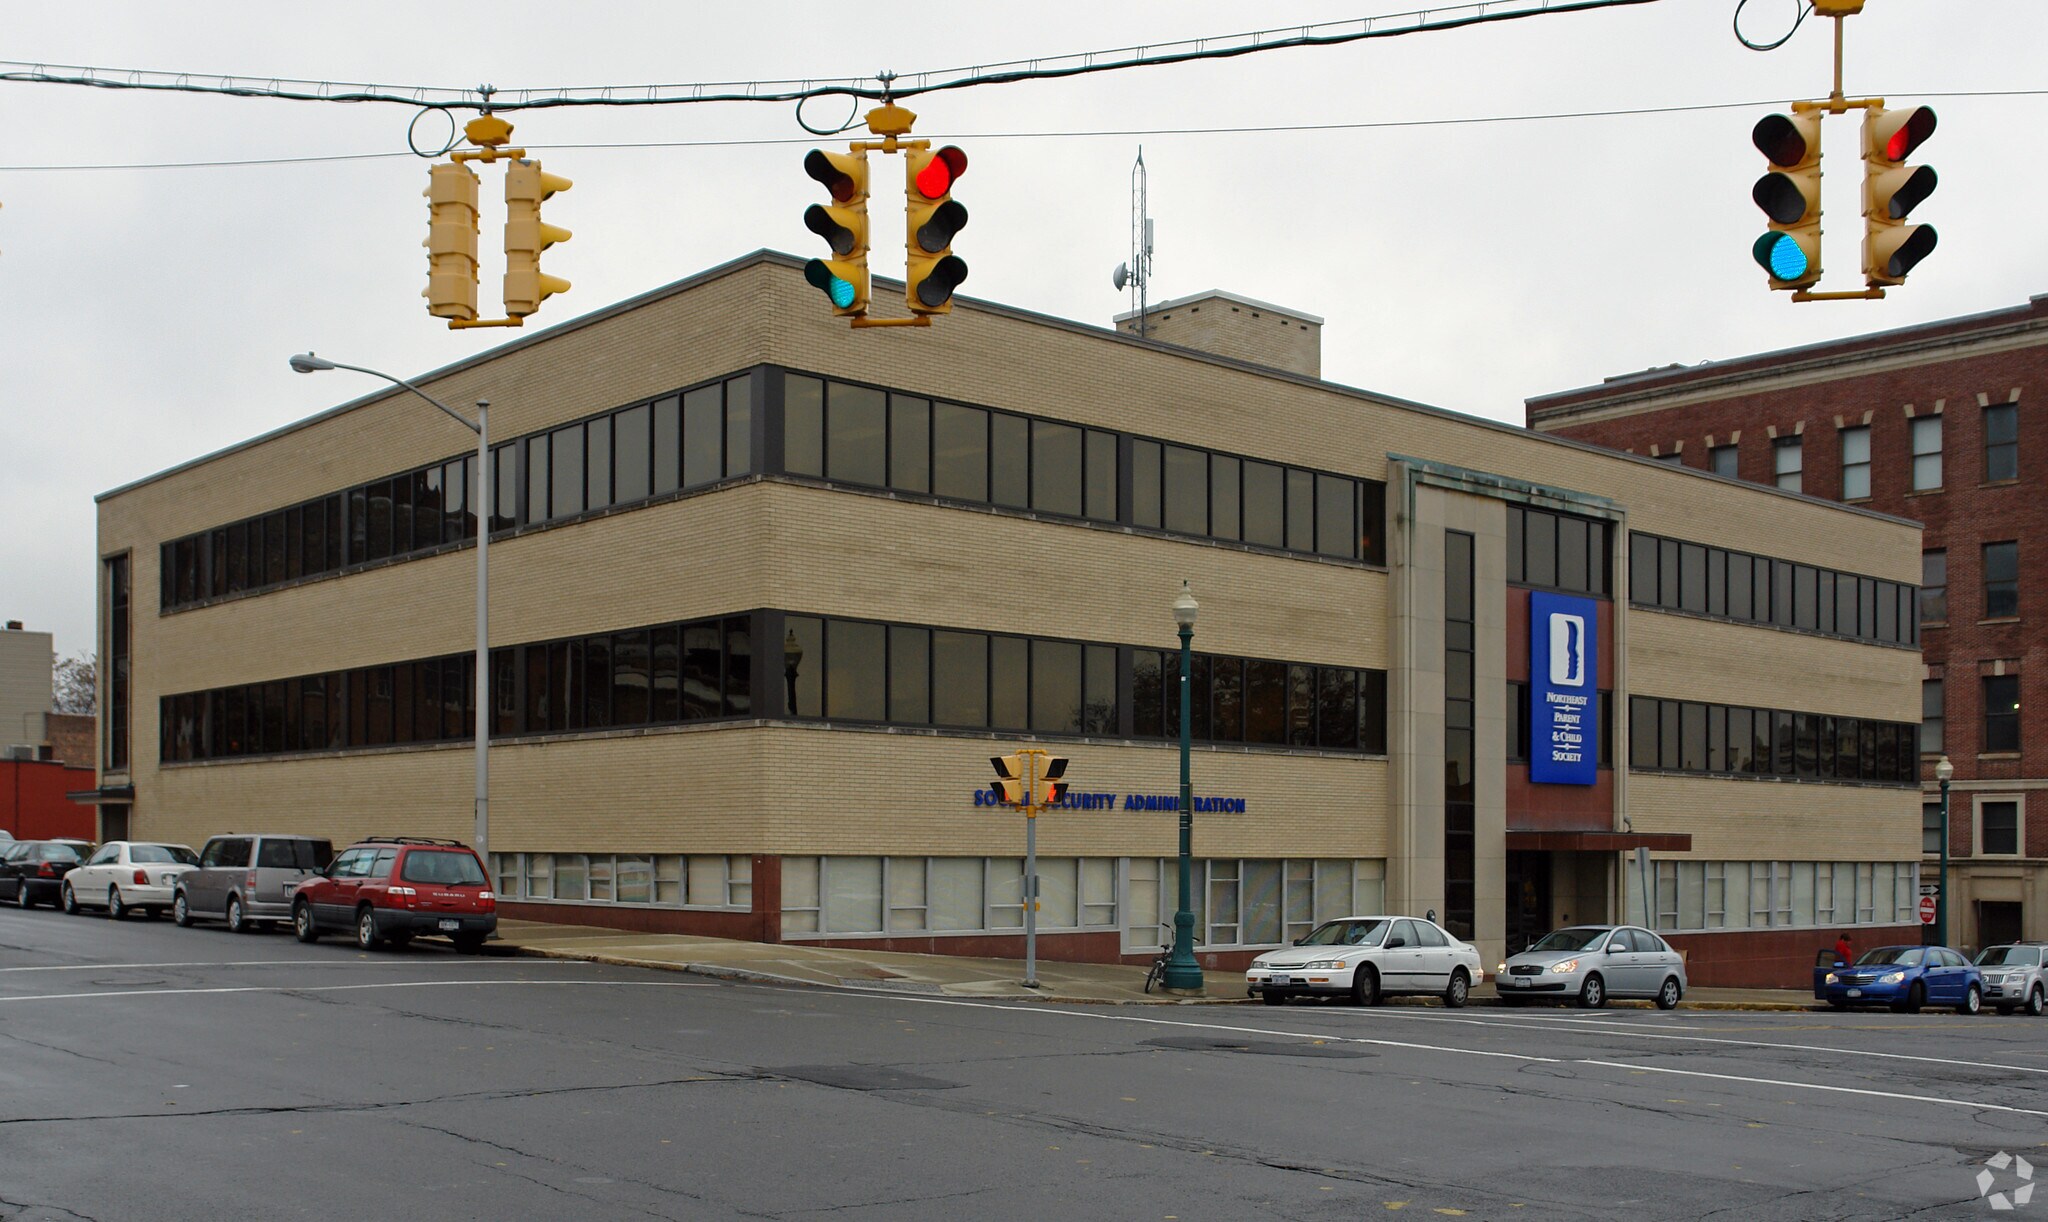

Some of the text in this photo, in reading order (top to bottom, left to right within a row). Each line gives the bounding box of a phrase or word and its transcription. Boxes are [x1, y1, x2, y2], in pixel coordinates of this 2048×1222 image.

[1552, 731, 1560, 742] &
[1042, 790, 1117, 810] CURITY
[1124, 794, 1246, 814] ADMINIRATION
